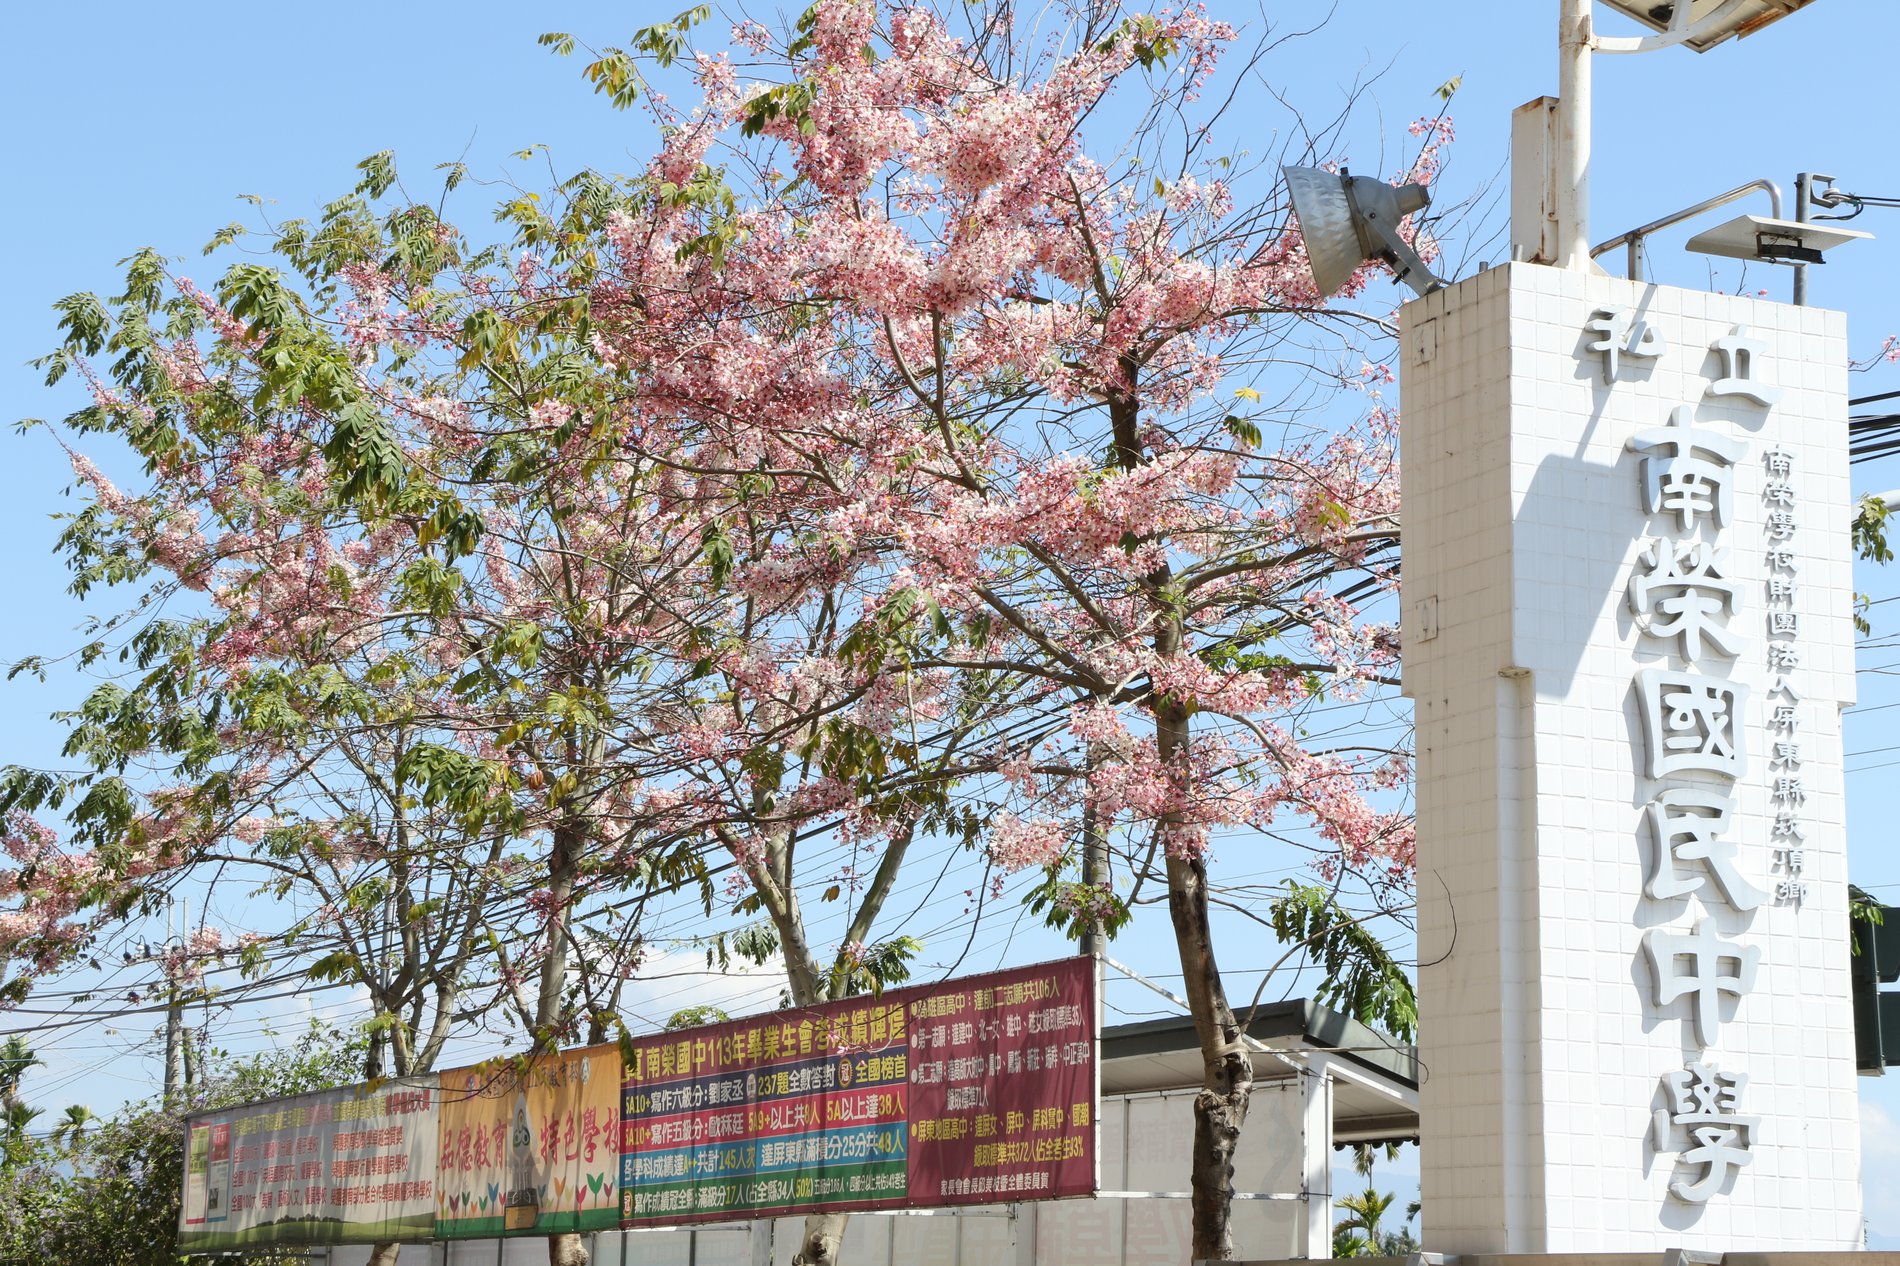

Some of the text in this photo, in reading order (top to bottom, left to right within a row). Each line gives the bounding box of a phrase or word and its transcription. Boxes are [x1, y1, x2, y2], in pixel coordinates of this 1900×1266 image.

[1585, 304, 1785, 407] 私立
[1626, 405, 1769, 1202] 南榮國民中學
[855, 1054, 907, 1083] 全國榜首
[827, 1091, 905, 1121] 5A以上達38人
[439, 1116, 507, 1173] 品德教育
[540, 1107, 621, 1166] 特色學校
